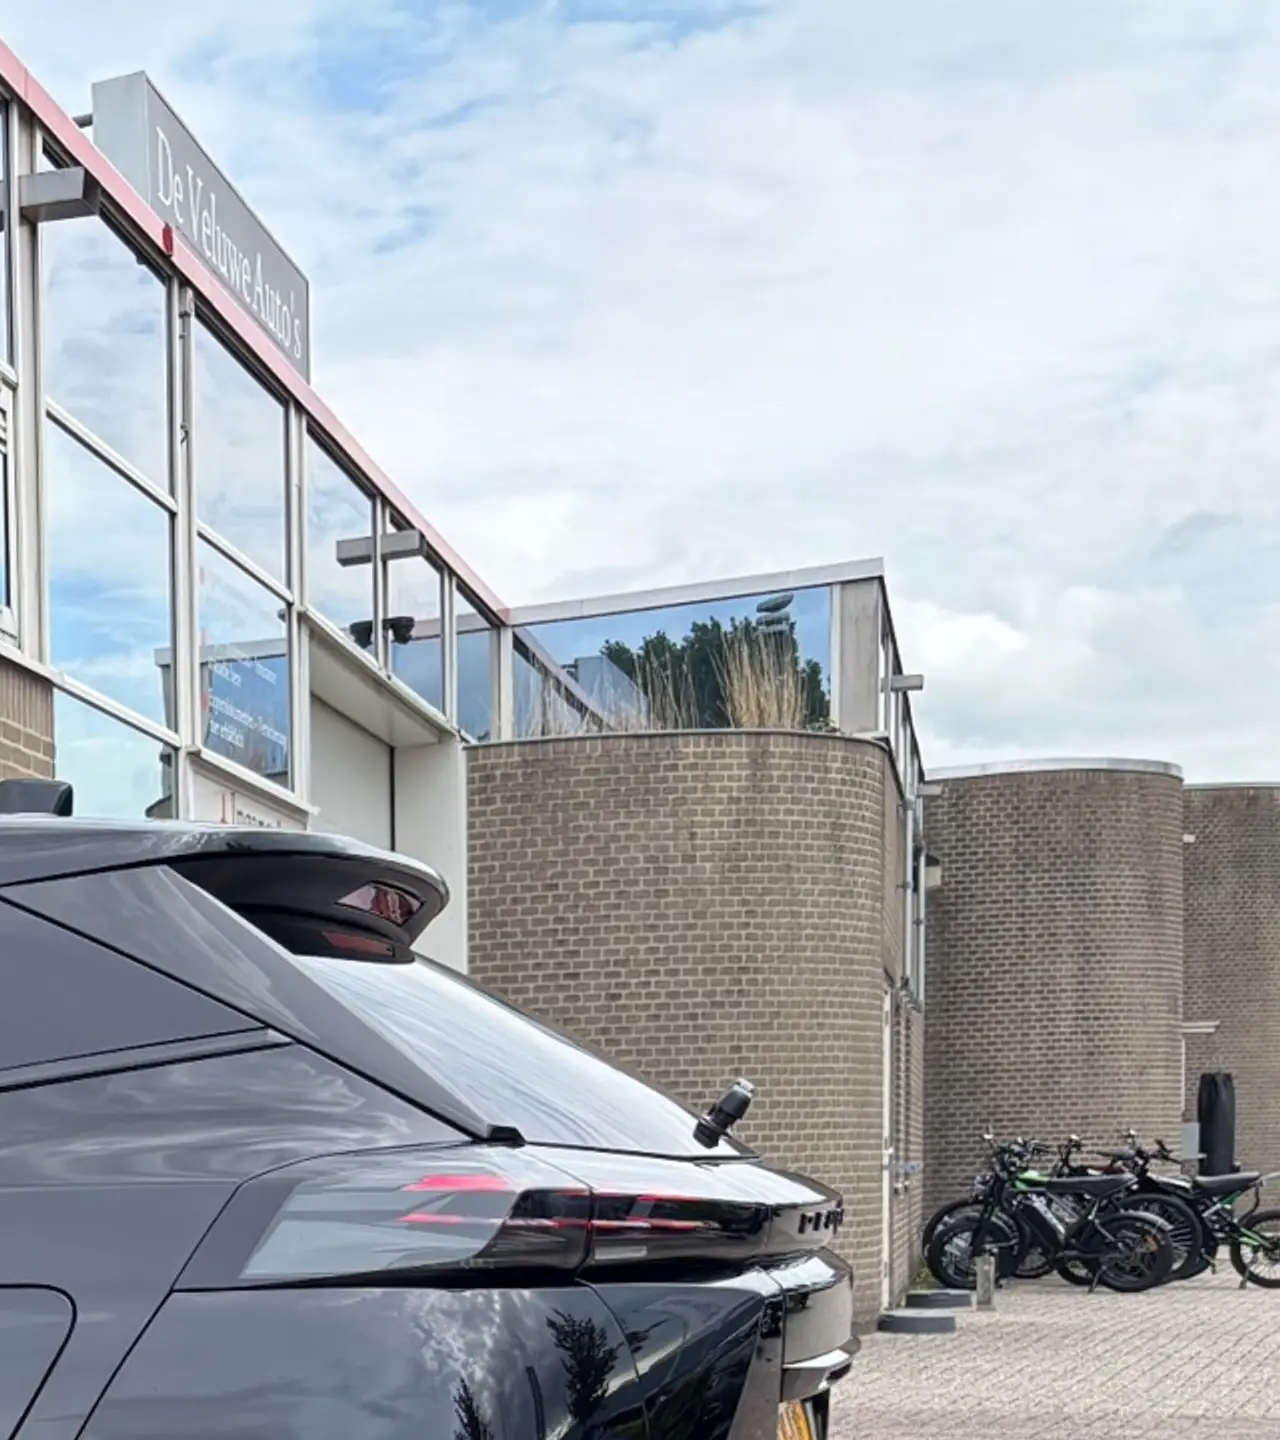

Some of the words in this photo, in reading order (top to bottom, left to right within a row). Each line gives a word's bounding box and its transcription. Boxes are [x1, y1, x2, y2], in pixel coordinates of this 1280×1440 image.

[156, 126, 184, 223] De
[186, 164, 252, 302] Veluwe
[252, 251, 301, 359] Auto's
